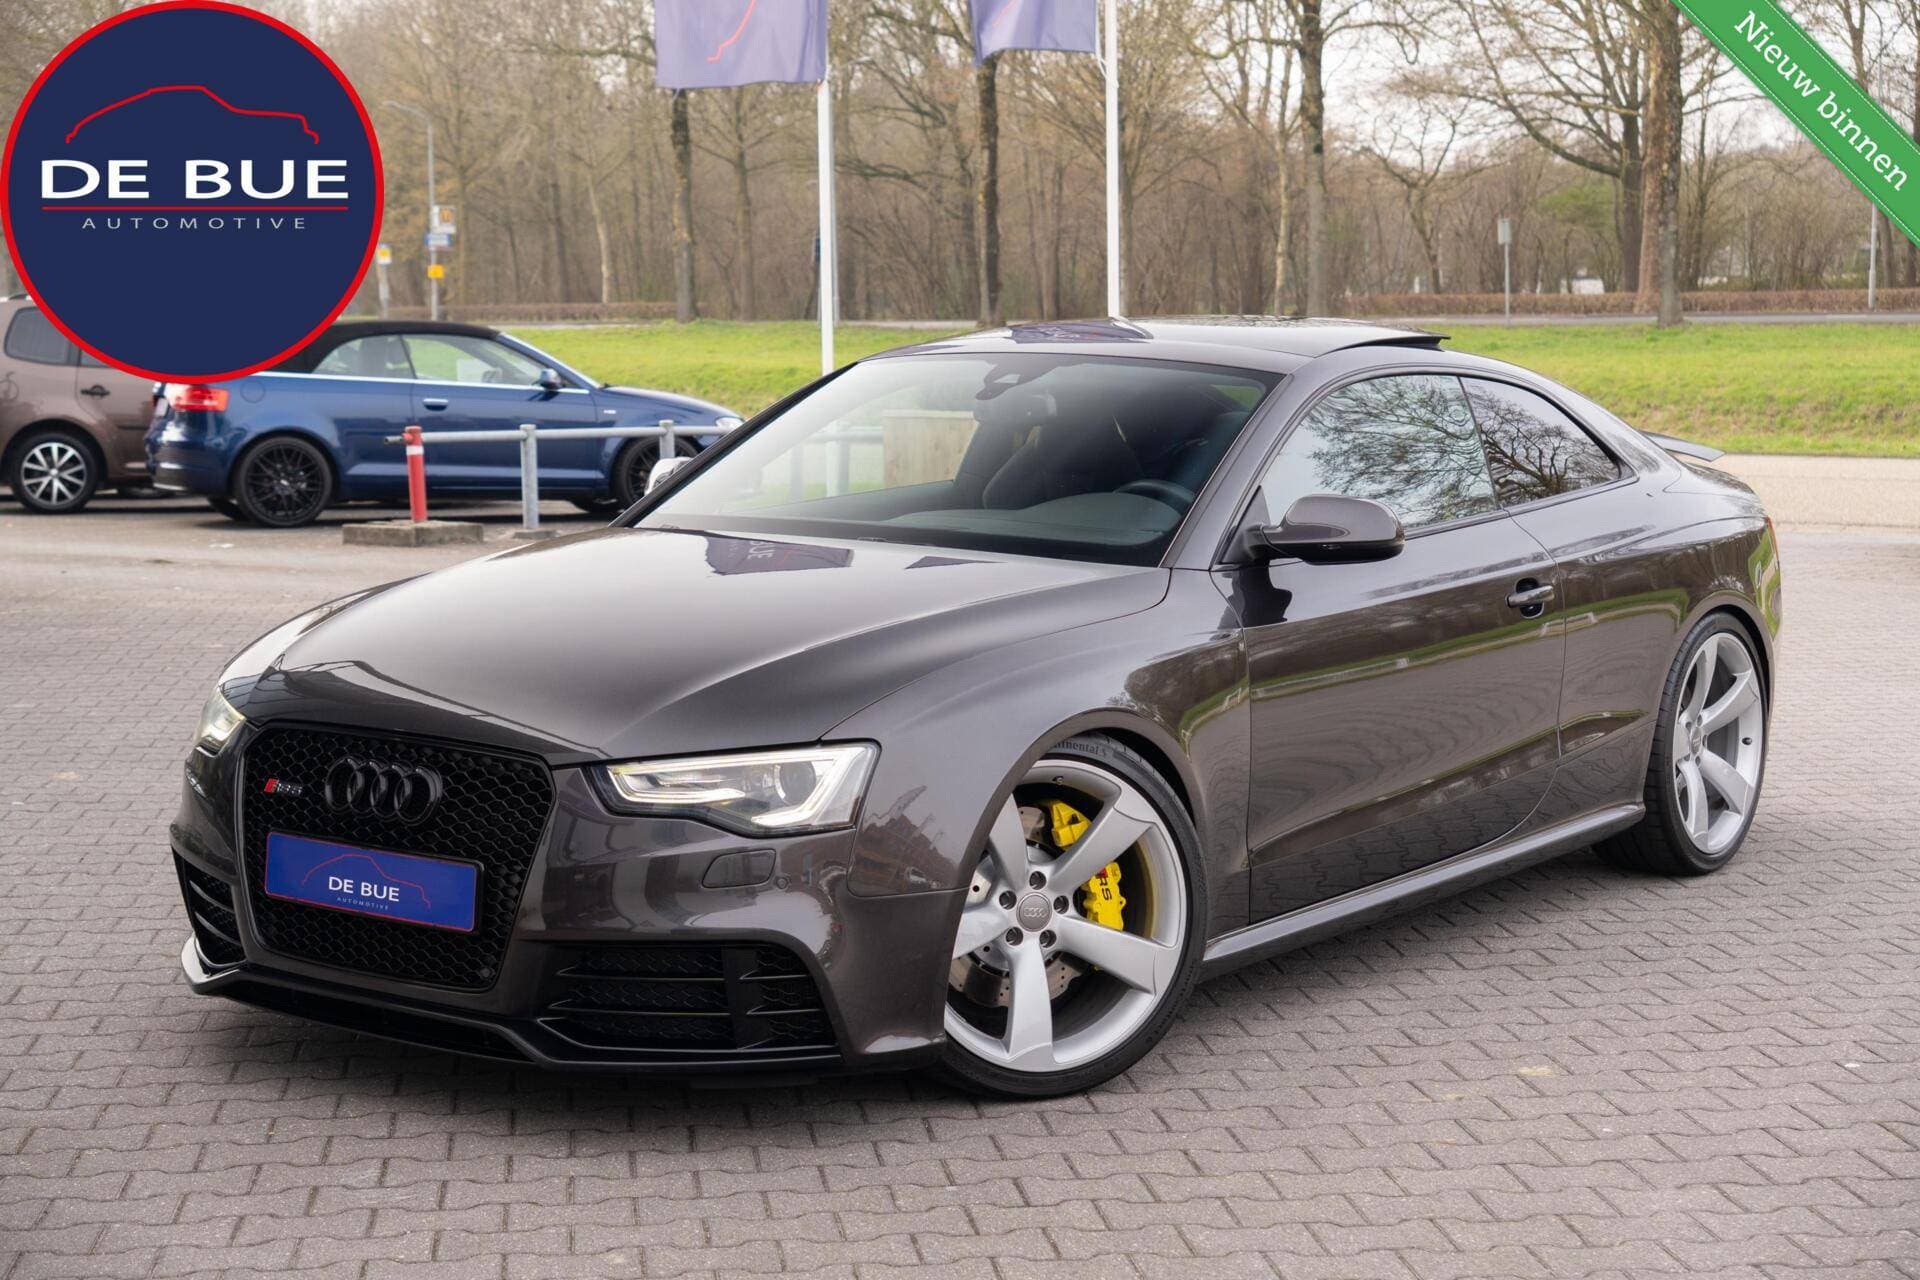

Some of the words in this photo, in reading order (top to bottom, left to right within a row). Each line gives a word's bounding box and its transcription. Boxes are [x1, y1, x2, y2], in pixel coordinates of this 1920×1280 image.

[328, 876, 354, 894] DE
[360, 882, 400, 902] BUE
[1099, 876, 1112, 901] RS
[336, 897, 389, 911] AUTOMOTIVE
